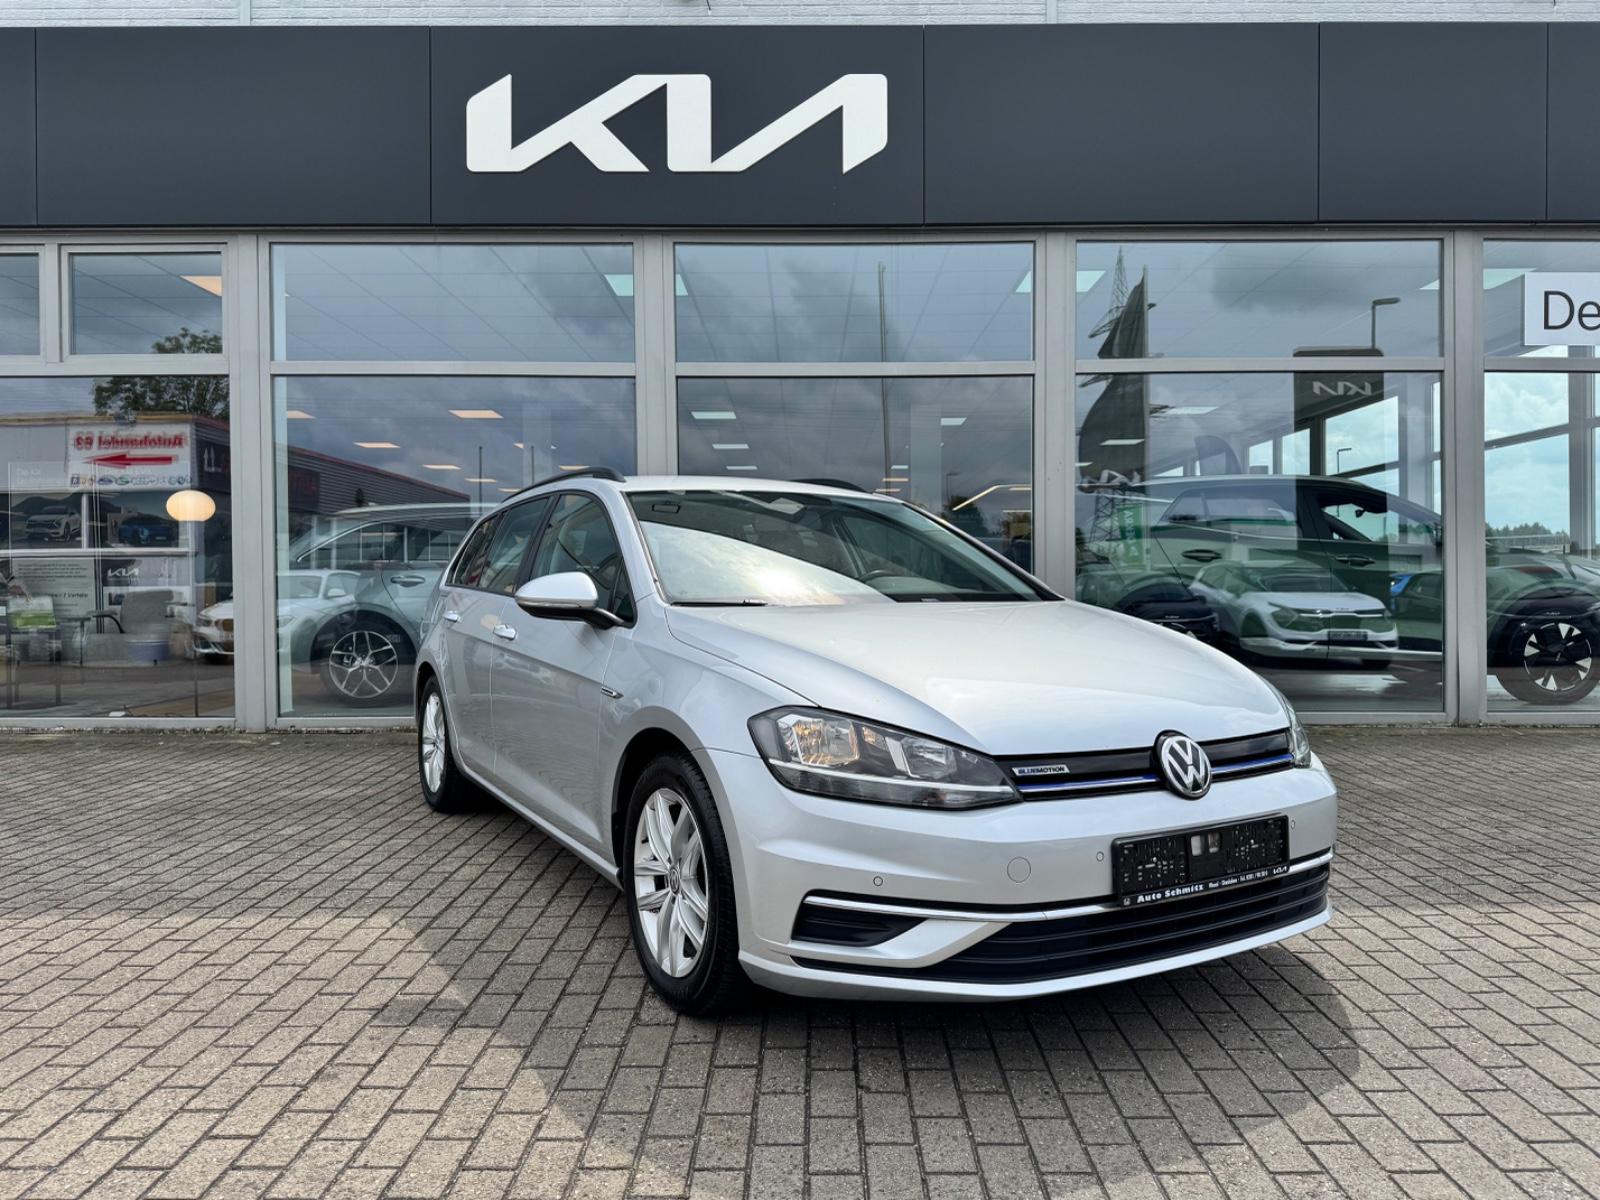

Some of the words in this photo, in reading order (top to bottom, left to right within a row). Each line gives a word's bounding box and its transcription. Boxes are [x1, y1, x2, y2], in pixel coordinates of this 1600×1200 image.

[466, 73, 888, 174] KIA
[1544, 290, 1600, 331] De
[1017, 766, 1066, 775] BLUEMOTION
[1137, 893, 1162, 904] Auto
[1164, 885, 1204, 898] Schmitz
